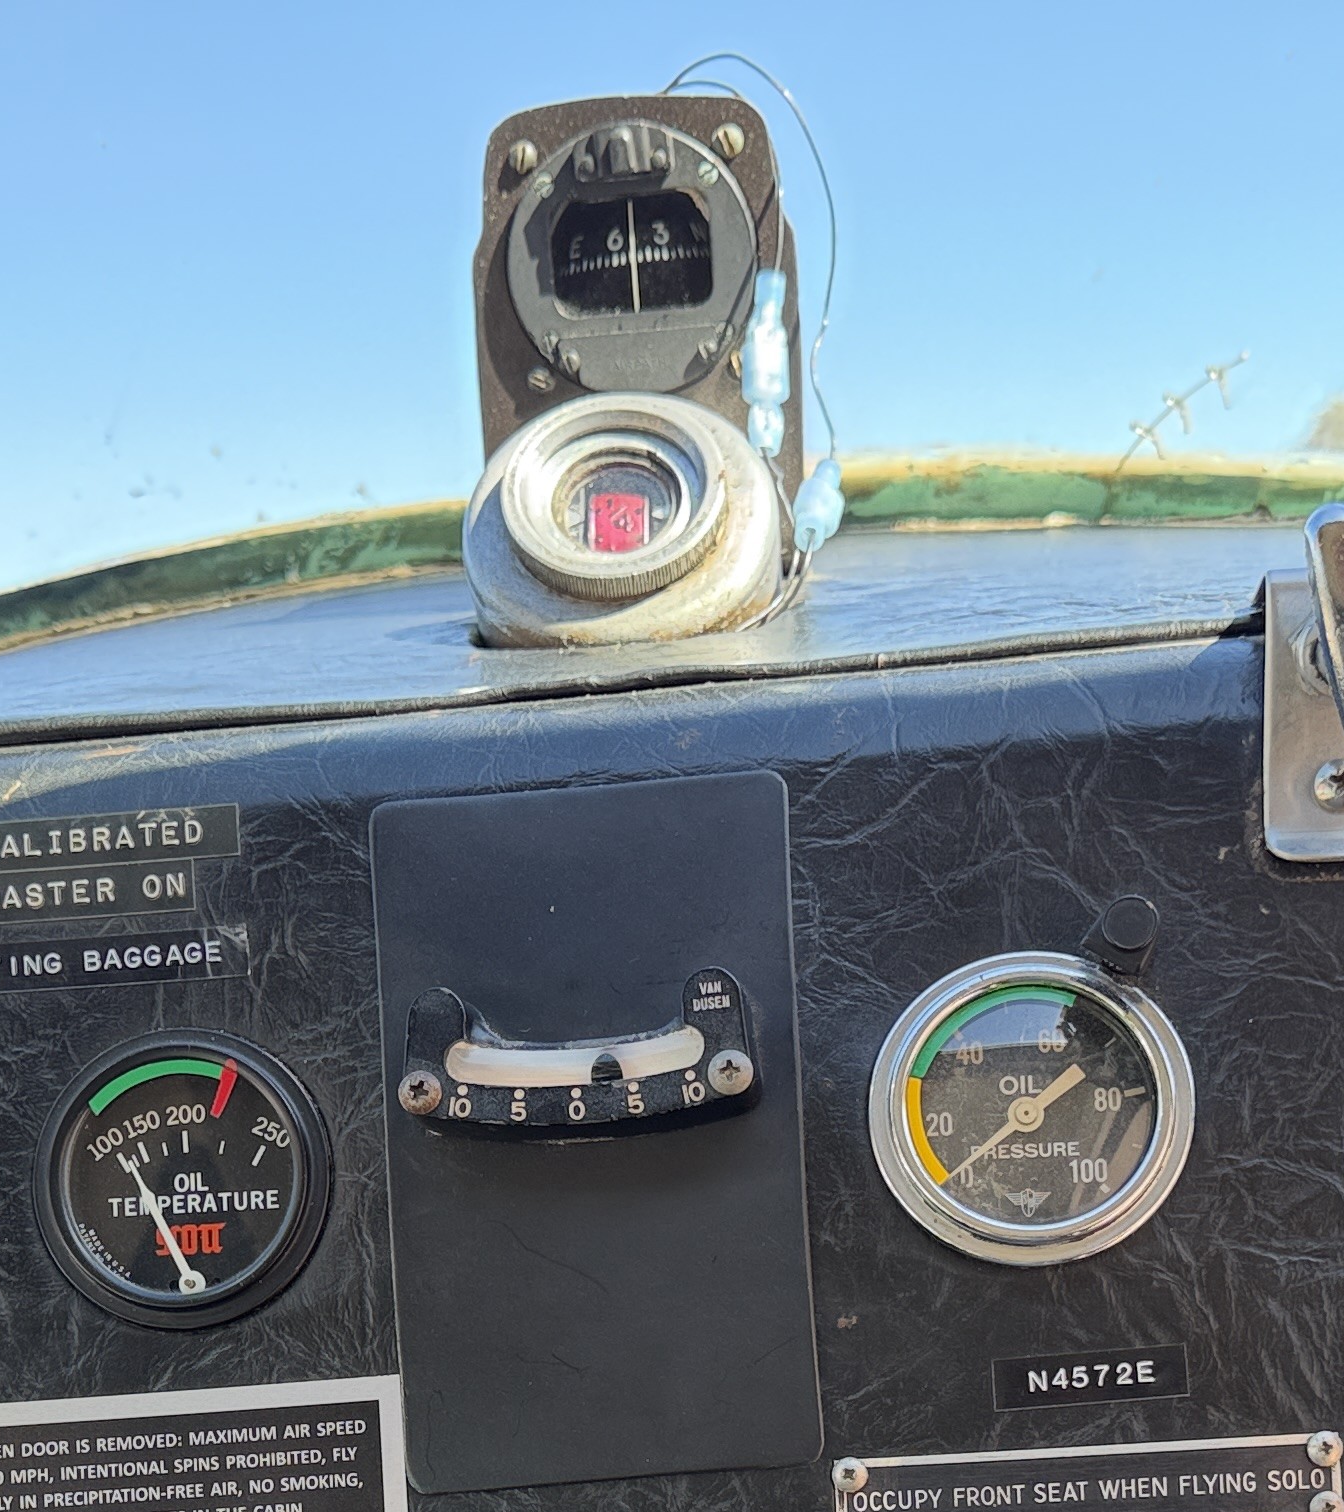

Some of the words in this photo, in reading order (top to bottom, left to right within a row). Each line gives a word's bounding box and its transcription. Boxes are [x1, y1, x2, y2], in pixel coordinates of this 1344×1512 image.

[607, 227, 624, 252] 6
[651, 220, 670, 245] 3
[141, 872, 187, 899] ON
[83, 940, 223, 972] BAGGAGE
[699, 980, 722, 996] VAN
[692, 995, 730, 1012] DUSEN
[448, 1097, 472, 1119] 10
[681, 1081, 705, 1104] 10
[998, 1075, 1043, 1096] OIL
[1094, 1087, 1122, 1112] 80
[123, 1110, 160, 1139] 150
[166, 1104, 206, 1127] 200
[925, 1112, 953, 1137] 20
[87, 1127, 124, 1162] 100
[251, 1116, 290, 1148] 250
[174, 1173, 209, 1193] OIL
[1069, 1158, 1107, 1183] 100
[108, 1189, 280, 1218] TEMPERATURE
[1028, 1360, 1156, 1393] N4572E
[20, 1439, 69, 1458] DOOR
[75, 1438, 91, 1454] IS
[95, 1432, 183, 1453] REMOVED:
[188, 1426, 278, 1447] MAXIMUM
[282, 1423, 311, 1441] AIR
[316, 1419, 367, 1438] SPEED
[10, 1466, 55, 1487] MPH,
[60, 1460, 169, 1482] INTENTIONAL
[173, 1456, 220, 1474] SPINS
[225, 1449, 327, 1471] PROHIBITED,
[333, 1446, 358, 1464] FLY
[19, 1494, 37, 1510] IN
[43, 1483, 205, 1508] PRECIPITATION-FREE
[210, 1480, 244, 1499] AIR,
[249, 1477, 275, 1495] NO
[280, 1472, 364, 1493] SMOKING,
[953, 1484, 1026, 1508] FRONT
[1033, 1481, 1088, 1505] SEAT
[1098, 1476, 1169, 1501] WHEN
[1178, 1471, 1257, 1496] FLYING
[1267, 1468, 1325, 1492] SOLO
